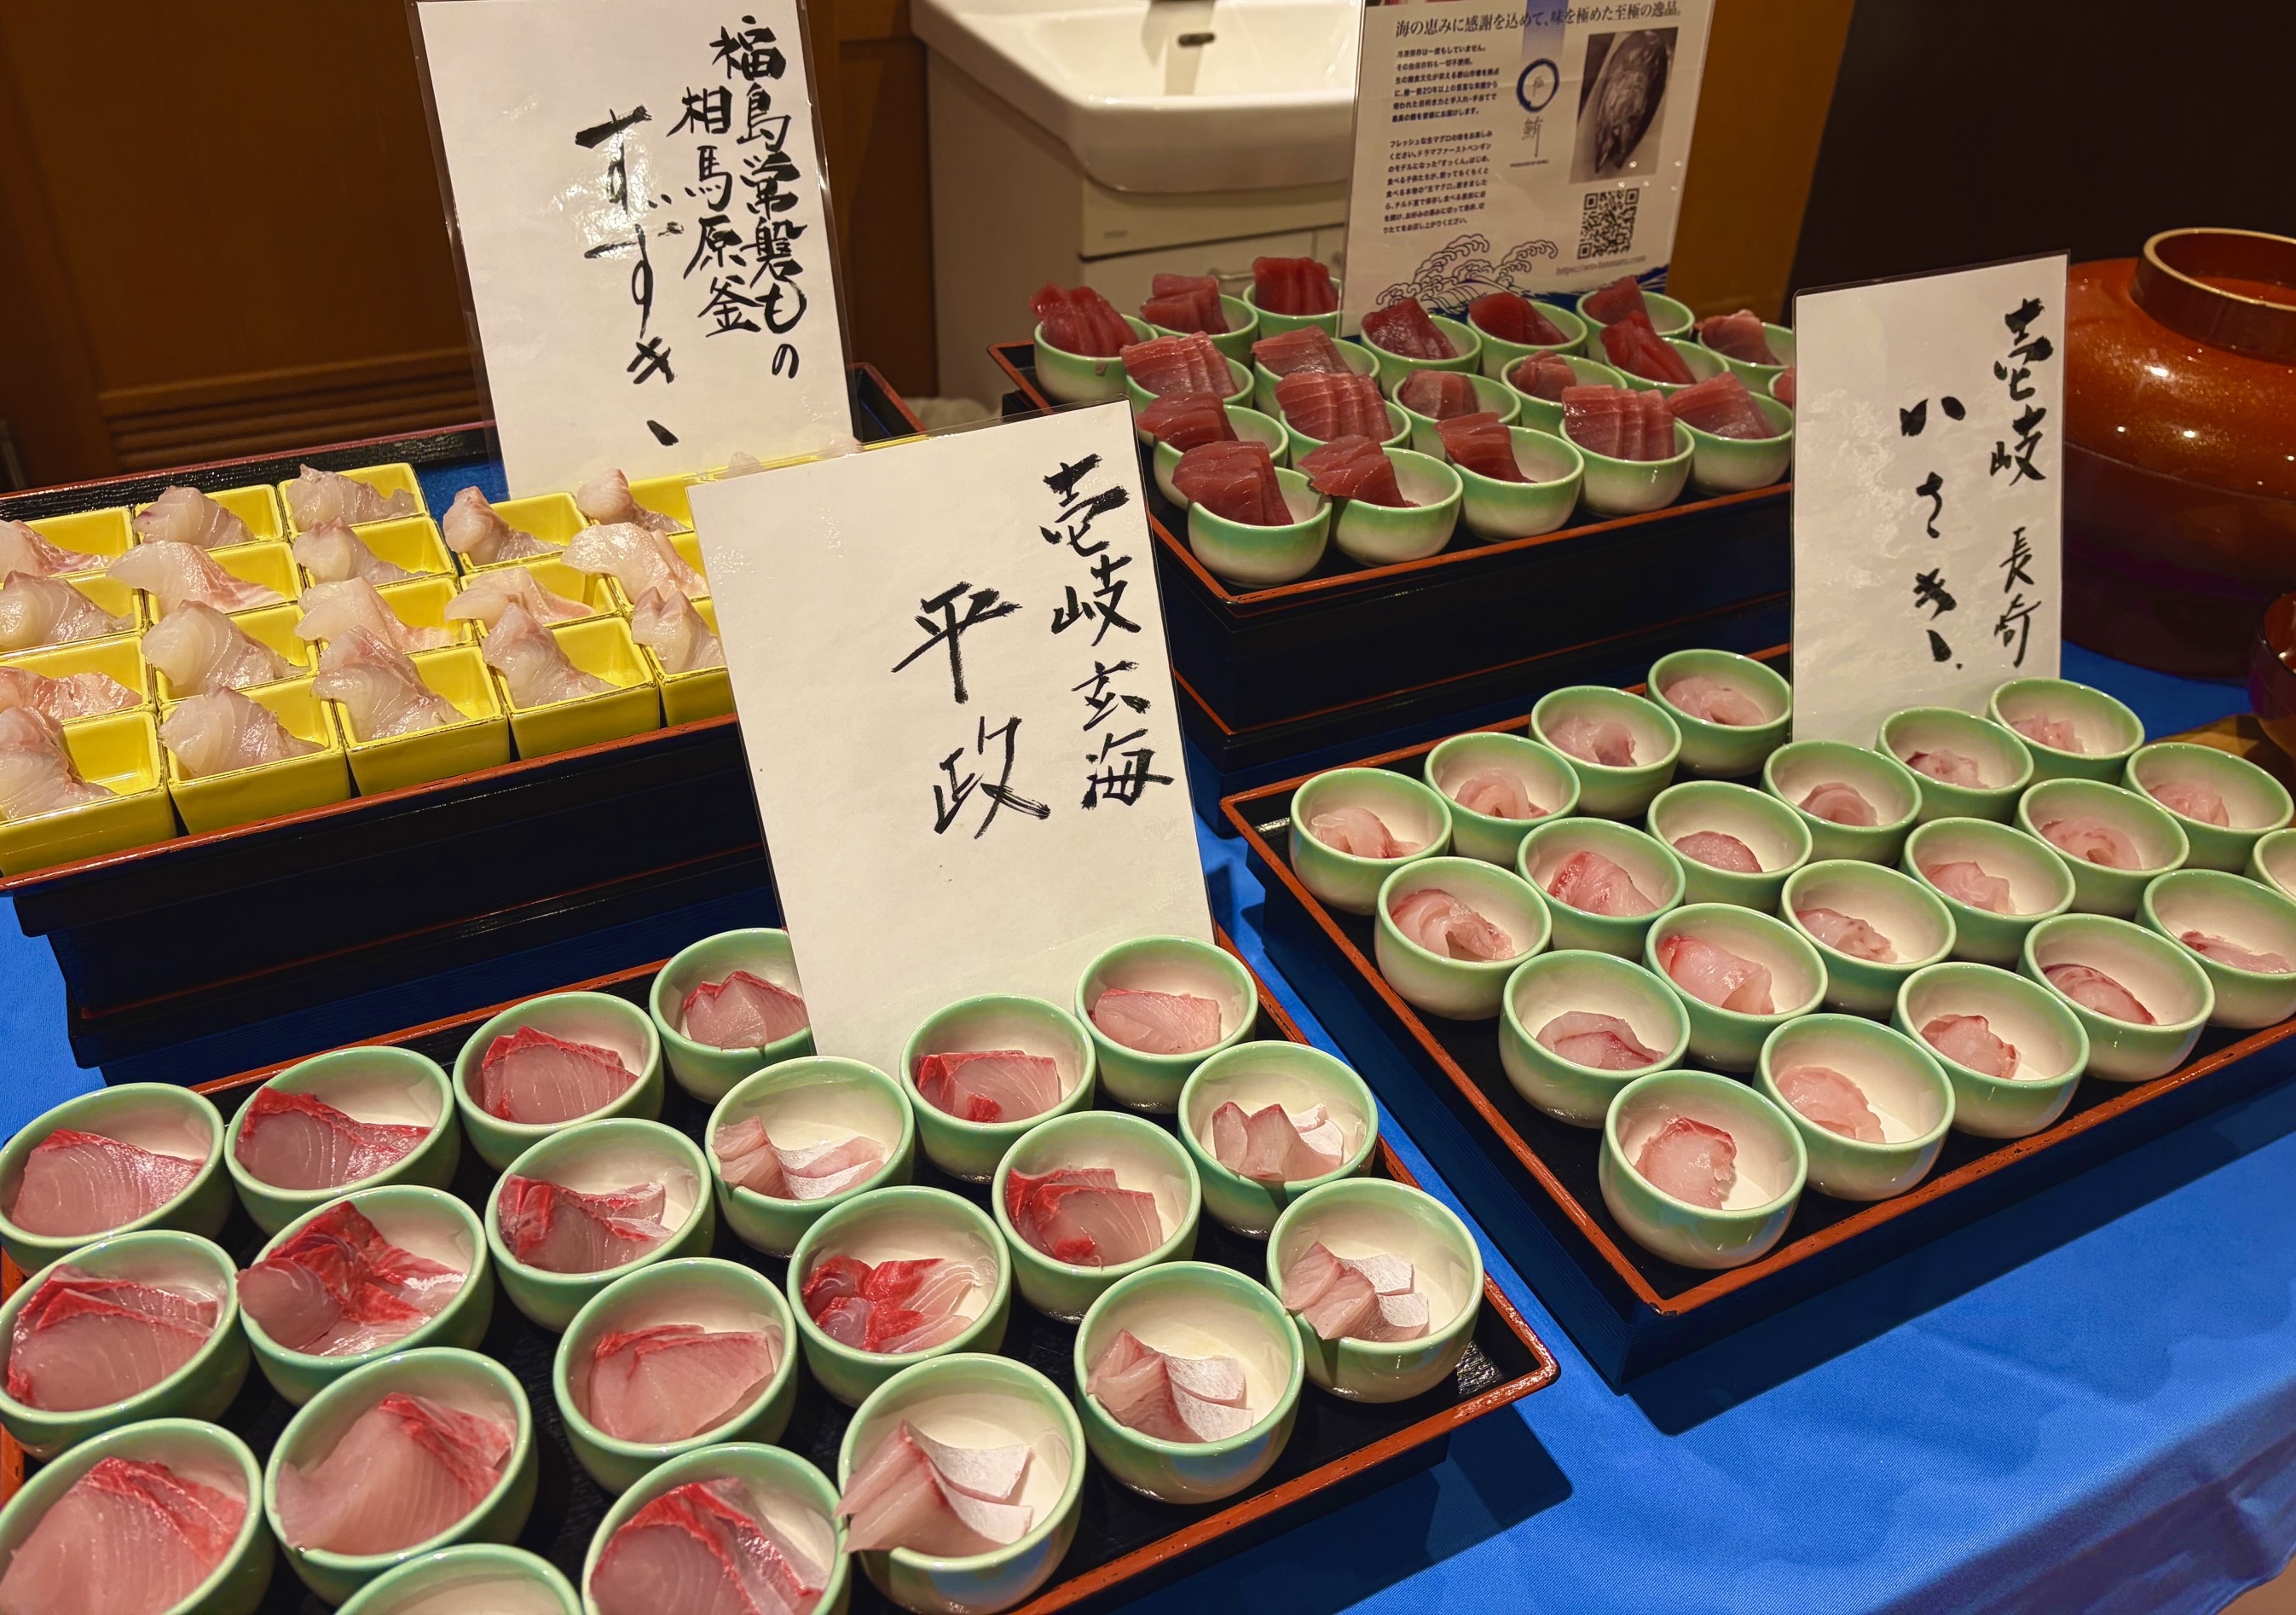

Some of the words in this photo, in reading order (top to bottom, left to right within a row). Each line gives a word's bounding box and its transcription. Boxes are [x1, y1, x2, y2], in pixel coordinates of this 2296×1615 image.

[666, 86, 761, 337] 相馬原釜
[709, 15, 807, 379] 福島常磐もの
[1989, 298, 2054, 486] 壱岐
[890, 581, 1051, 840] 平政
